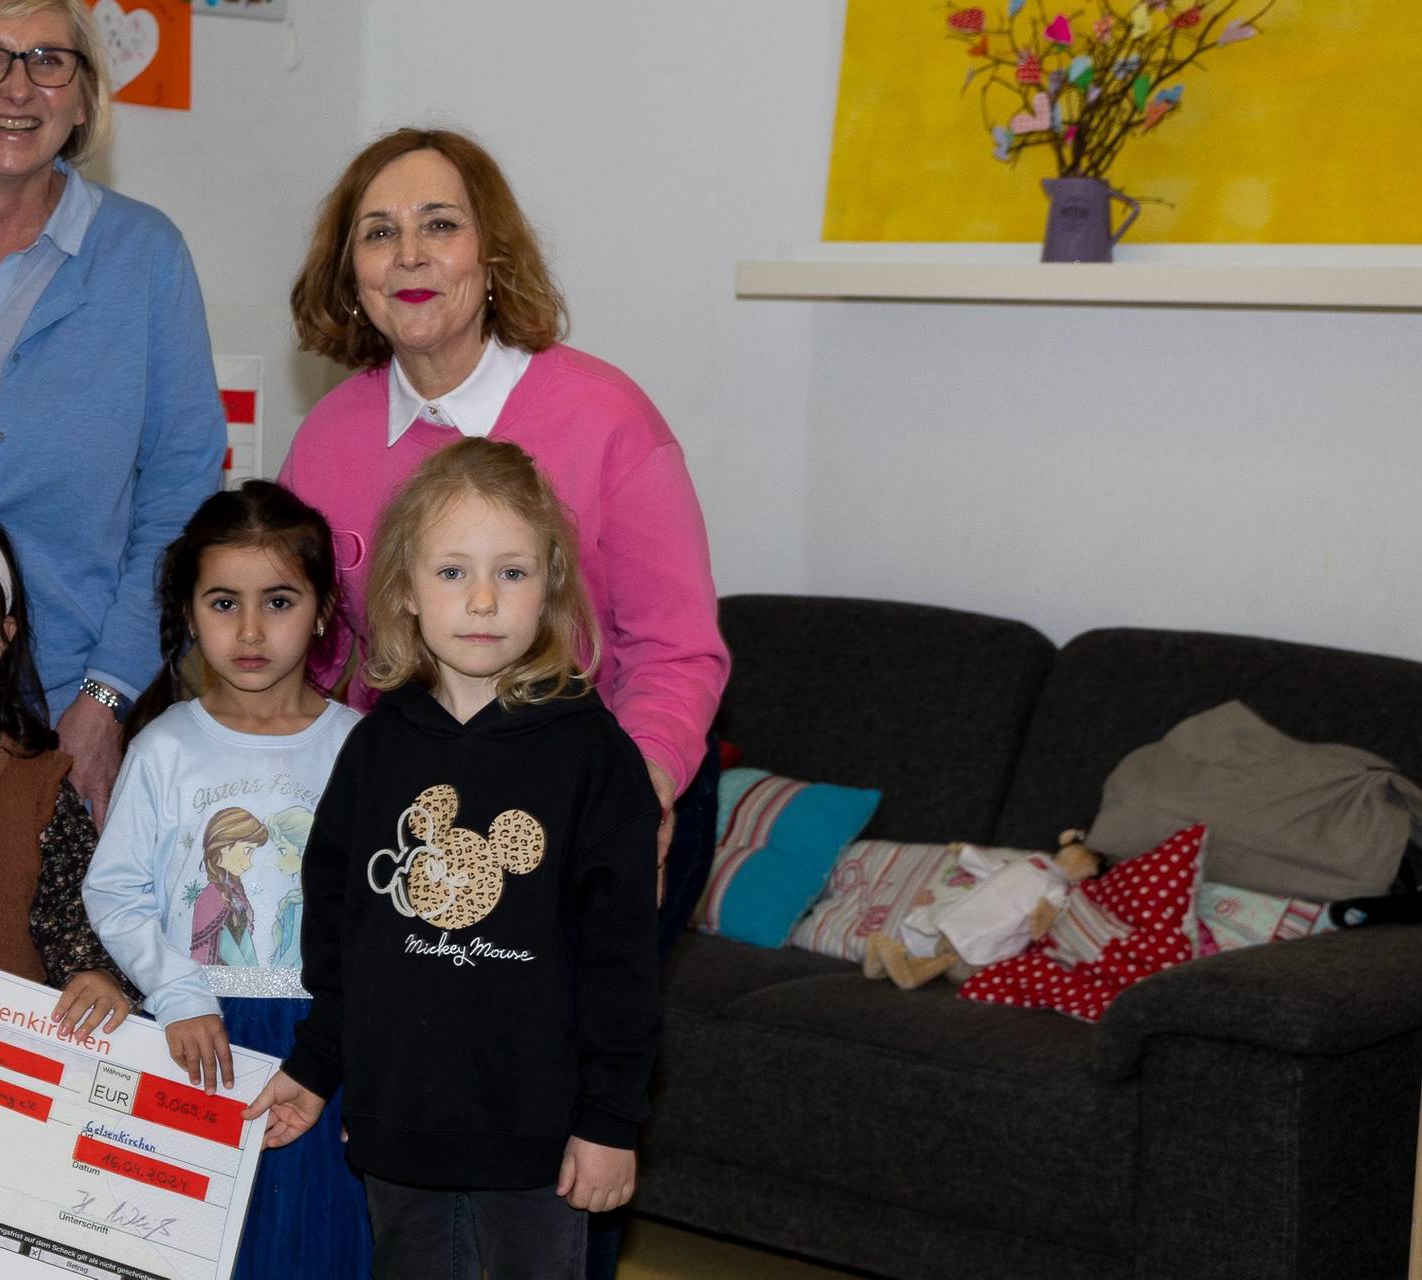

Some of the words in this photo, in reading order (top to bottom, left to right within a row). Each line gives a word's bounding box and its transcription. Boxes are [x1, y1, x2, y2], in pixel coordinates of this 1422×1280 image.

[404, 931, 475, 966] Mickey
[469, 937, 535, 961] Mouse
[102, 1066, 132, 1082] Währung
[93, 1084, 130, 1107] EUR
[82, 1120, 157, 1154] Gelsenkirchen
[72, 1160, 101, 1177] Datum
[58, 1211, 110, 1236] Unterschrift
[24, 1235, 36, 1245] auf
[35, 1239, 51, 1250] dem
[51, 1244, 77, 1259] Scheck
[77, 1252, 89, 1263] gilt
[88, 1256, 99, 1265] als
[99, 1260, 117, 1271] nicht
[66, 1261, 89, 1274] Betrag
